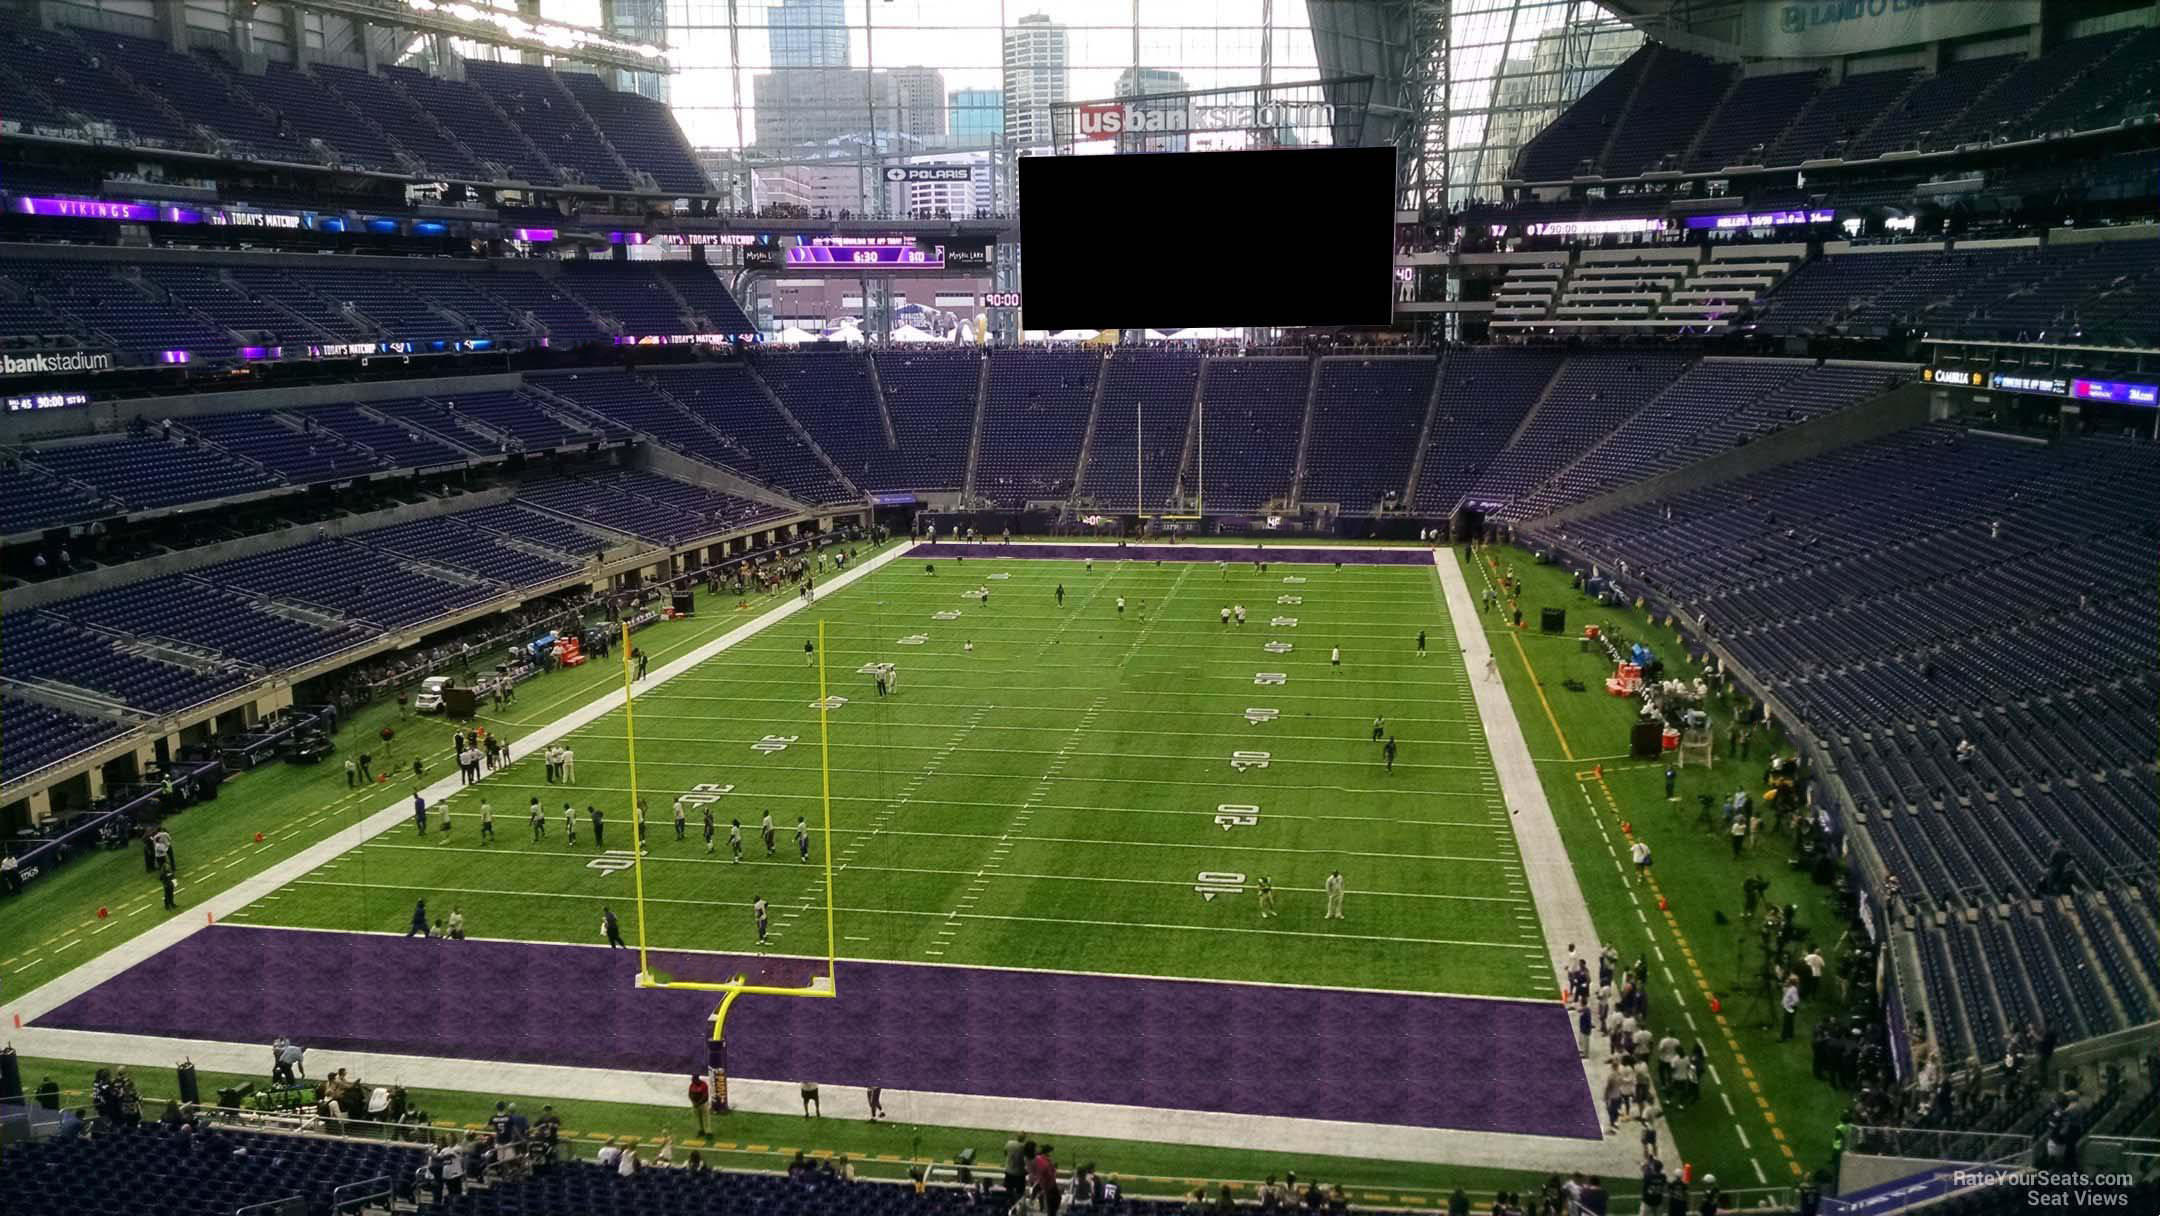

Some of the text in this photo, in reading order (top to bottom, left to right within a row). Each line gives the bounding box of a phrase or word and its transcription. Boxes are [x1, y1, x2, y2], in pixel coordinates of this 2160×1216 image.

[909, 169, 968, 179] POLARIS
[59, 201, 129, 217] VIKINGS
[231, 212, 264, 226] TODAY'S
[265, 214, 300, 229] MATCHUP
[689, 234, 756, 245] TODAY'S MATCHUP
[853, 251, 878, 263] 6:30
[1396, 267, 1412, 281] 40
[986, 294, 1019, 306] 90:00
[323, 344, 348, 356] TODAY'S
[1934, 370, 1969, 384] CAMBRIA
[37, 395, 64, 408] 90:00
